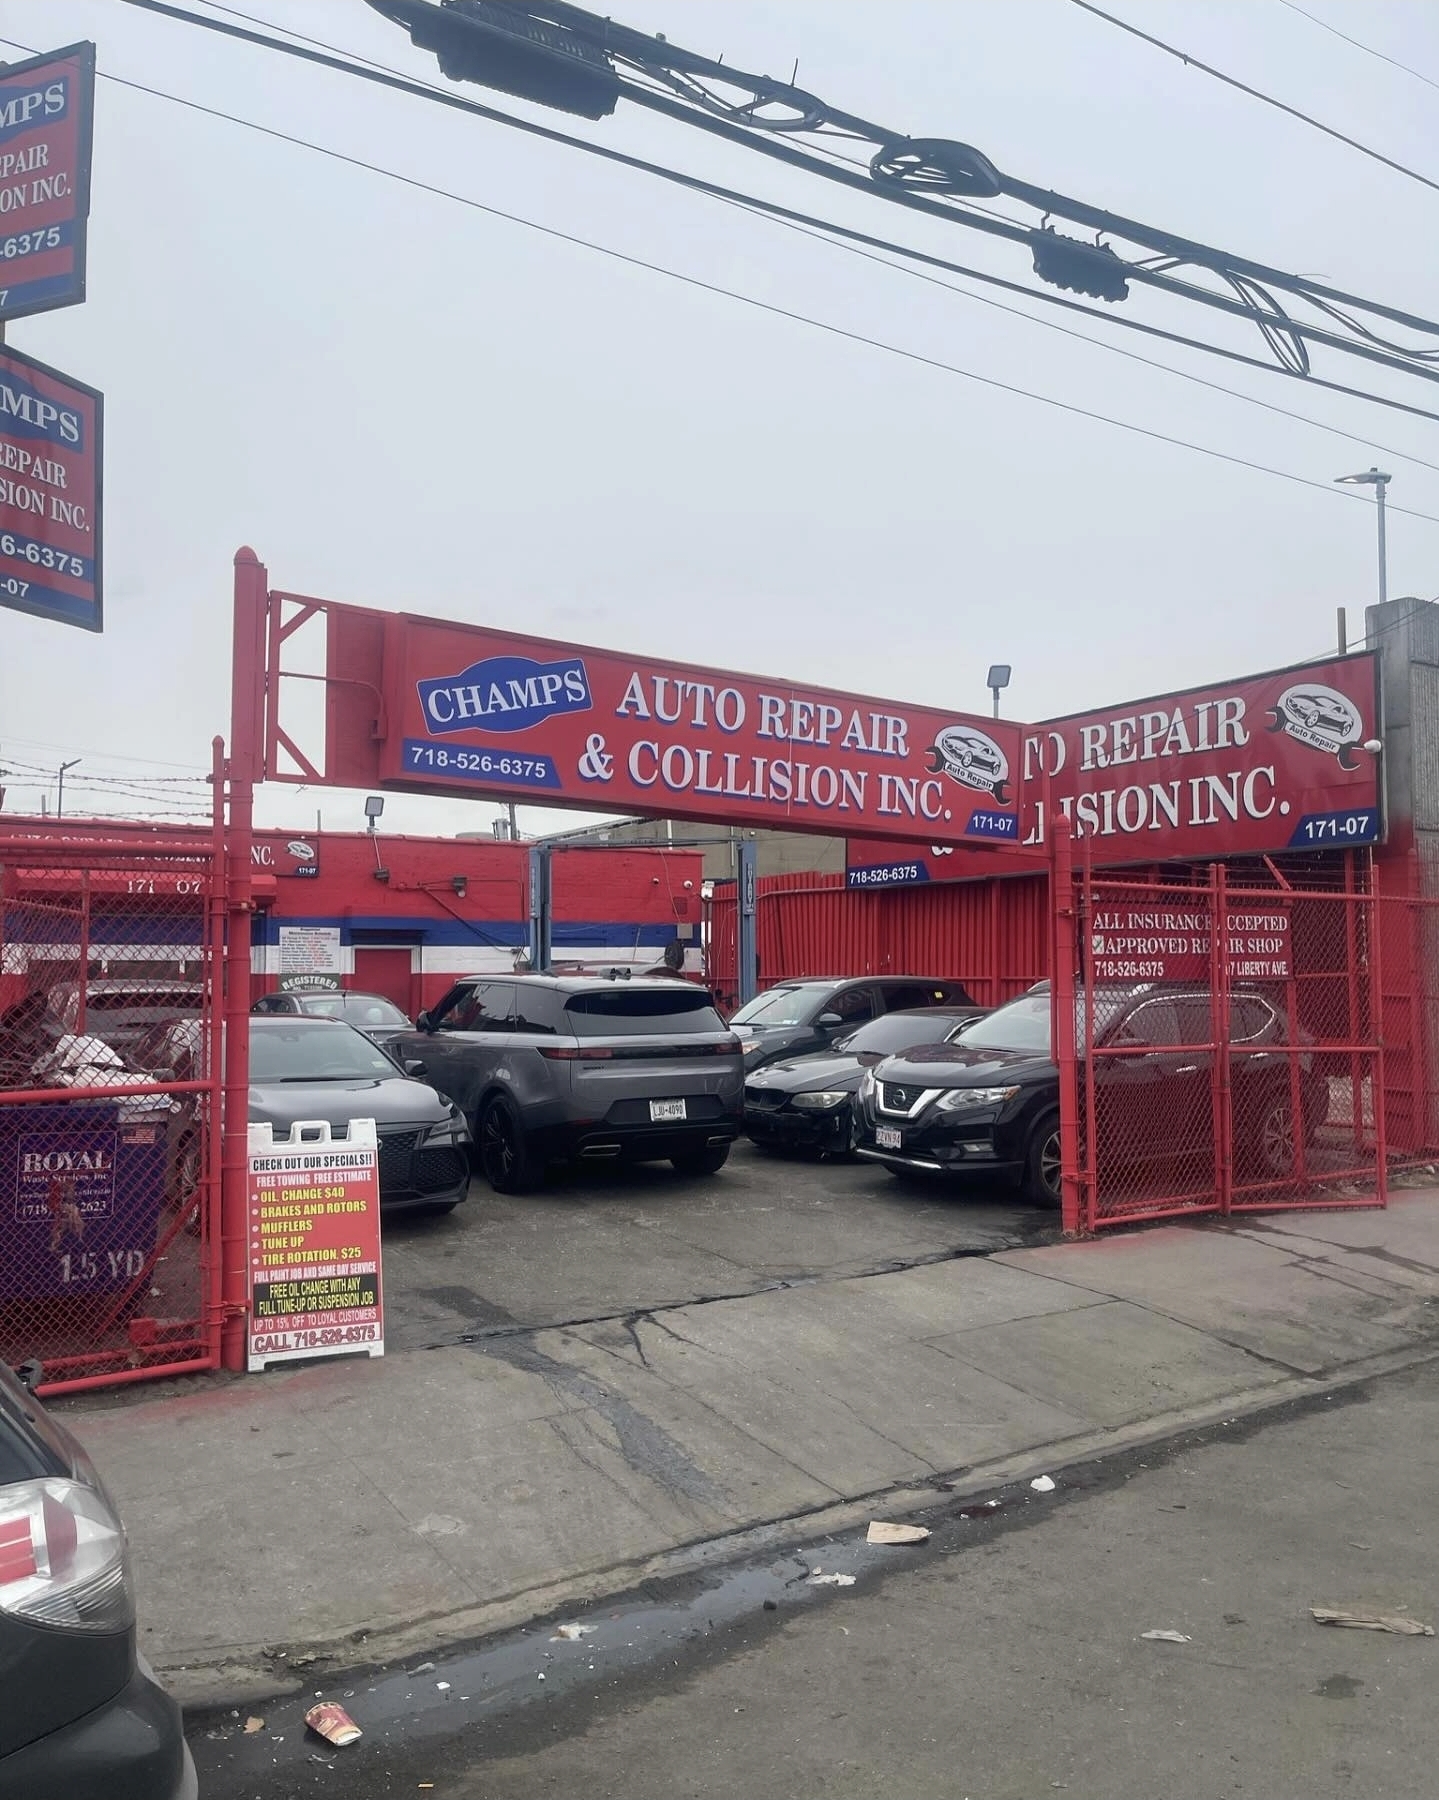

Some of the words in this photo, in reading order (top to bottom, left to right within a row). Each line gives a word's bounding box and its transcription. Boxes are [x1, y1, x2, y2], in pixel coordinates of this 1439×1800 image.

[0, 143, 48, 178] PAIR
[31, 172, 71, 204] INC.
[51, 496, 90, 532] INC.
[427, 669, 586, 723] CHAMPS
[616, 671, 746, 732] AUTO
[757, 693, 910, 760] REPAIR
[1079, 696, 1250, 771] REPAIR
[1289, 724, 1308, 738] Auto
[1309, 733, 1336, 750] Repair
[411, 746, 546, 779] 718-526-6375
[578, 733, 614, 781] &
[628, 740, 868, 817] COLLISION
[877, 774, 952, 820] INC.
[946, 763, 966, 777] Auto
[967, 771, 993, 789] Repair
[1188, 765, 1290, 826] INC.
[972, 815, 1012, 832] 171-07
[1305, 815, 1369, 839] 171-07
[251, 845, 275, 866] NC.
[849, 865, 917, 884] 718-526-6375
[1092, 912, 1125, 930] ALL
[1217, 914, 1288, 932] CCEPTED
[1105, 937, 1188, 955] APPROVED
[1191, 937, 1245, 954] REIR
[1247, 937, 1283, 954] SHOP
[1094, 960, 1165, 977] 718-526-6375
[1236, 960, 1270, 976] LIBERTY
[281, 975, 338, 990] REGISTERED
[21, 1150, 112, 1173] ROYAL
[253, 1158, 283, 1171] CHECK
[284, 1157, 302, 1170] OUT
[304, 1156, 321, 1168] OUR
[324, 1153, 372, 1168] SPECIALS!!
[256, 1175, 276, 1188] FREE
[277, 1173, 310, 1187] TOWING
[313, 1172, 332, 1185] FREE
[333, 1170, 372, 1183] ESTIMATE
[281, 1187, 322, 1202] CHANGE
[324, 1186, 345, 1199] $40
[261, 1204, 302, 1218] BRAKES
[303, 1202, 324, 1216] AND
[326, 1200, 367, 1214] ROTORS
[261, 1219, 313, 1234] MUFFLERS
[261, 1237, 289, 1250] TUNE
[291, 1236, 304, 1248] UP
[262, 1253, 285, 1266] TIRE
[341, 1246, 361, 1260] $25
[318, 1264, 336, 1277] SAME
[270, 1283, 288, 1299] FREE
[289, 1282, 300, 1297] OIL
[301, 1280, 329, 1296] CHANGE
[330, 1278, 347, 1293] WITH
[347, 1276, 361, 1291] ANY
[259, 1300, 276, 1316] FULL
[277, 1298, 305, 1314] TUNE-UP
[307, 1296, 318, 1311] OR
[319, 1292, 360, 1310] SUSPENSION
[361, 1290, 374, 1306] JOB
[254, 1319, 263, 1332] UP
[265, 1318, 273, 1330] TO
[292, 1315, 305, 1328] OFF
[308, 1313, 317, 1326] TO
[318, 1312, 338, 1325] LOYAL
[338, 1307, 377, 1323] CUSTOMERS
[254, 1333, 292, 1352] CALL
[294, 1324, 376, 1348] 718-526-6375
